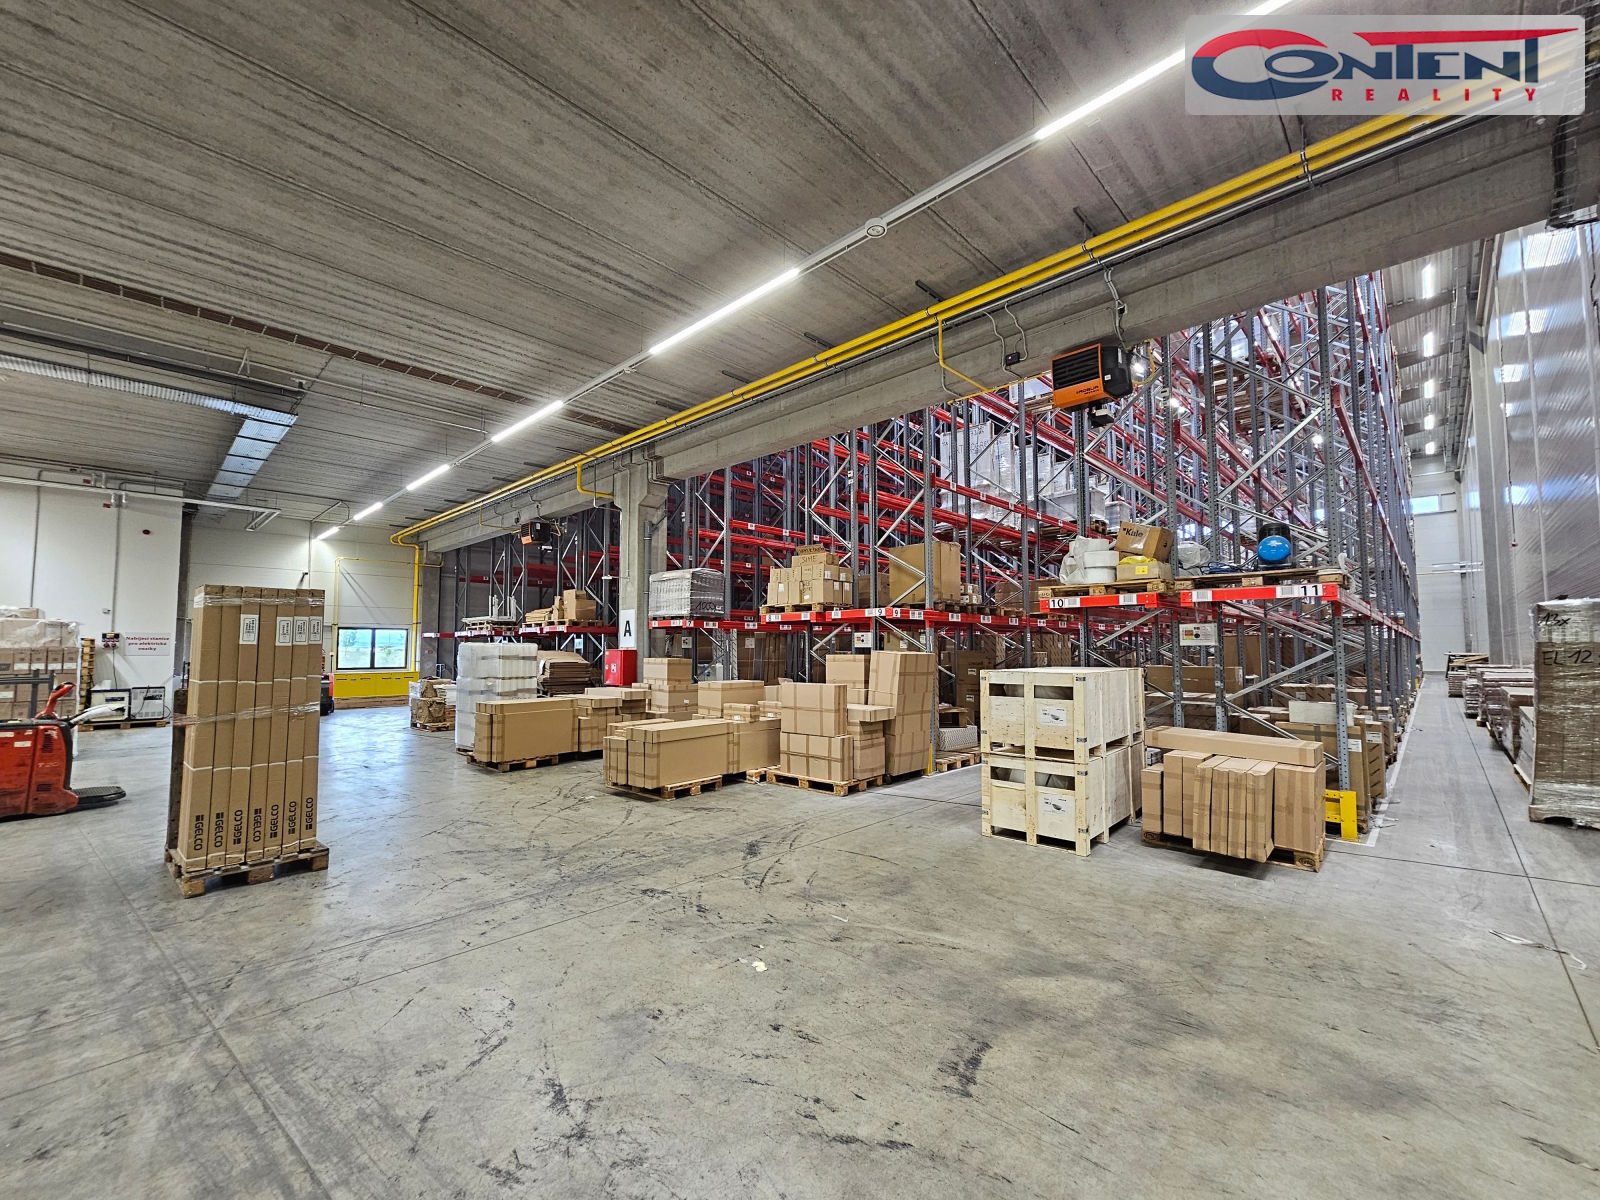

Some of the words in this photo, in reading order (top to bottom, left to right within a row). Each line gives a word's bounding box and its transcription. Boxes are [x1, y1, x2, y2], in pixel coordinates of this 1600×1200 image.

[1050, 598, 1064, 608] 10
[1300, 585, 1319, 596] 11
[623, 620, 632, 637] A
[1542, 650, 1564, 666] EL
[1568, 649, 1593, 664] 12
[234, 809, 243, 838] GELCO
[270, 804, 279, 832] GELCO
[288, 801, 297, 828] GELCO
[305, 797, 314, 823] GELCO
[193, 820, 204, 851] GELCO
[213, 819, 224, 848] GELCO
[252, 814, 262, 842] GELCO
